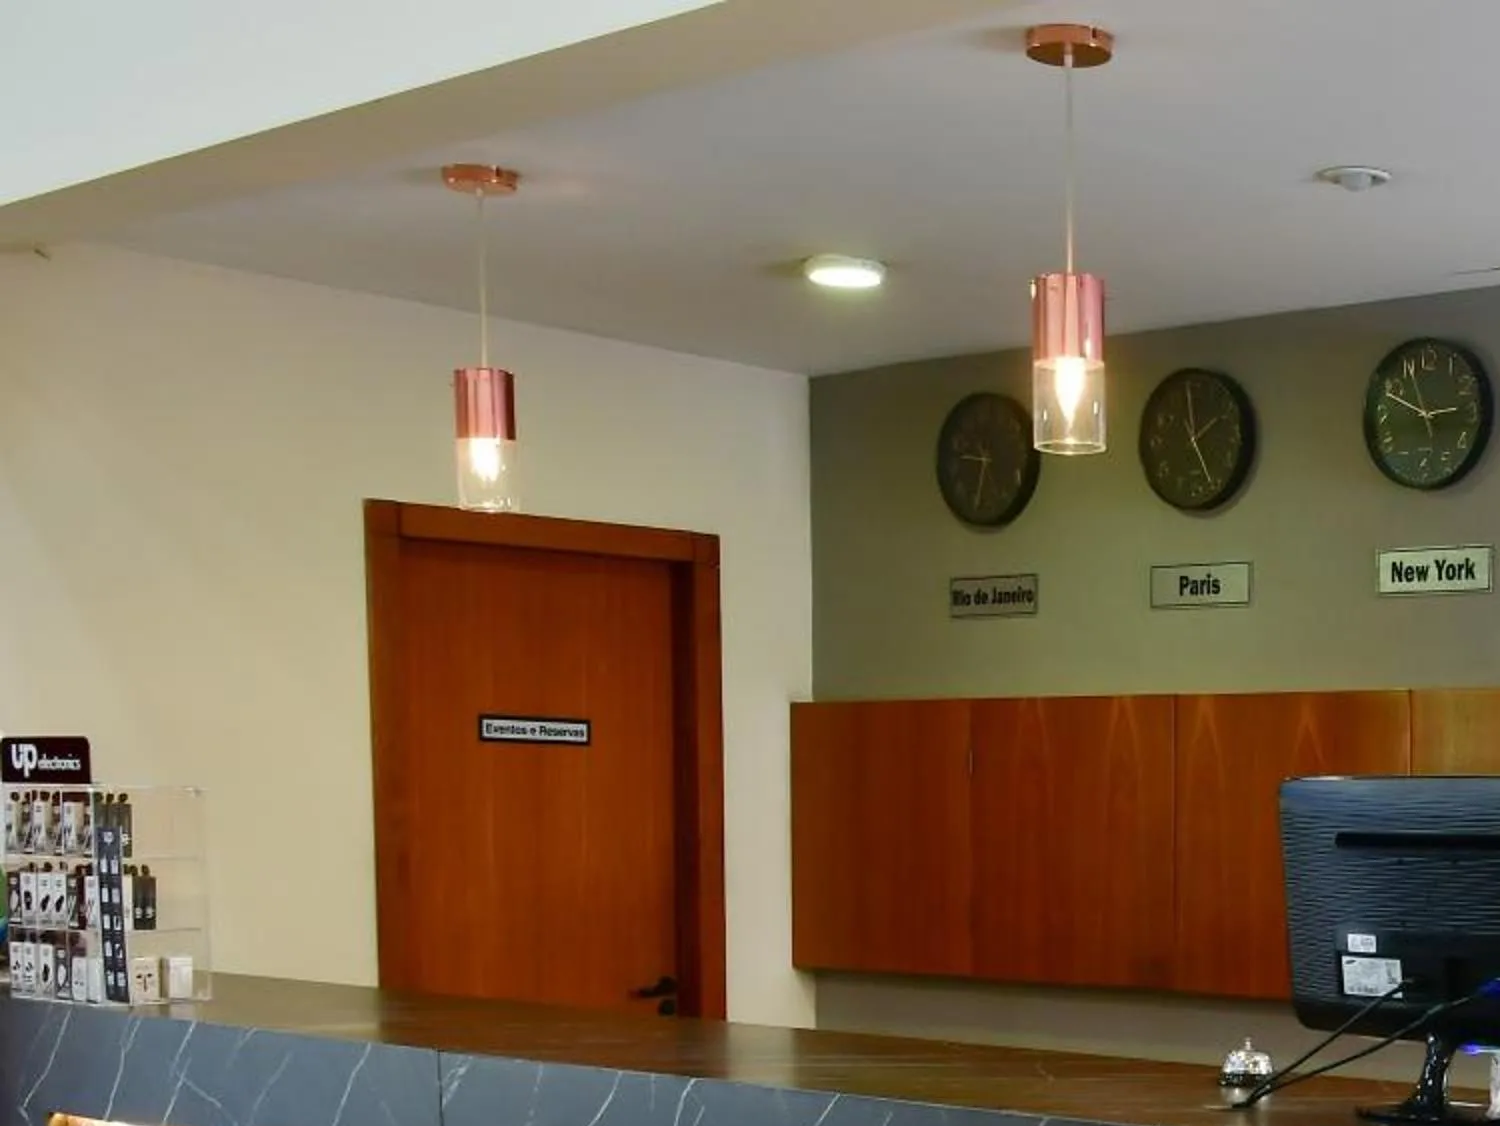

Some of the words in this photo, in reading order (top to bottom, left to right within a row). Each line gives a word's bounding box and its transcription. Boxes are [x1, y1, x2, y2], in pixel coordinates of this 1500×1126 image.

[1391, 560, 1430, 583] New
[1434, 557, 1476, 581] York
[1179, 573, 1221, 596] Paris
[952, 590, 971, 606] Rio
[974, 588, 988, 605] de
[992, 586, 1035, 605] Janeiro
[530, 727, 537, 736] e
[539, 725, 585, 737] Reservas
